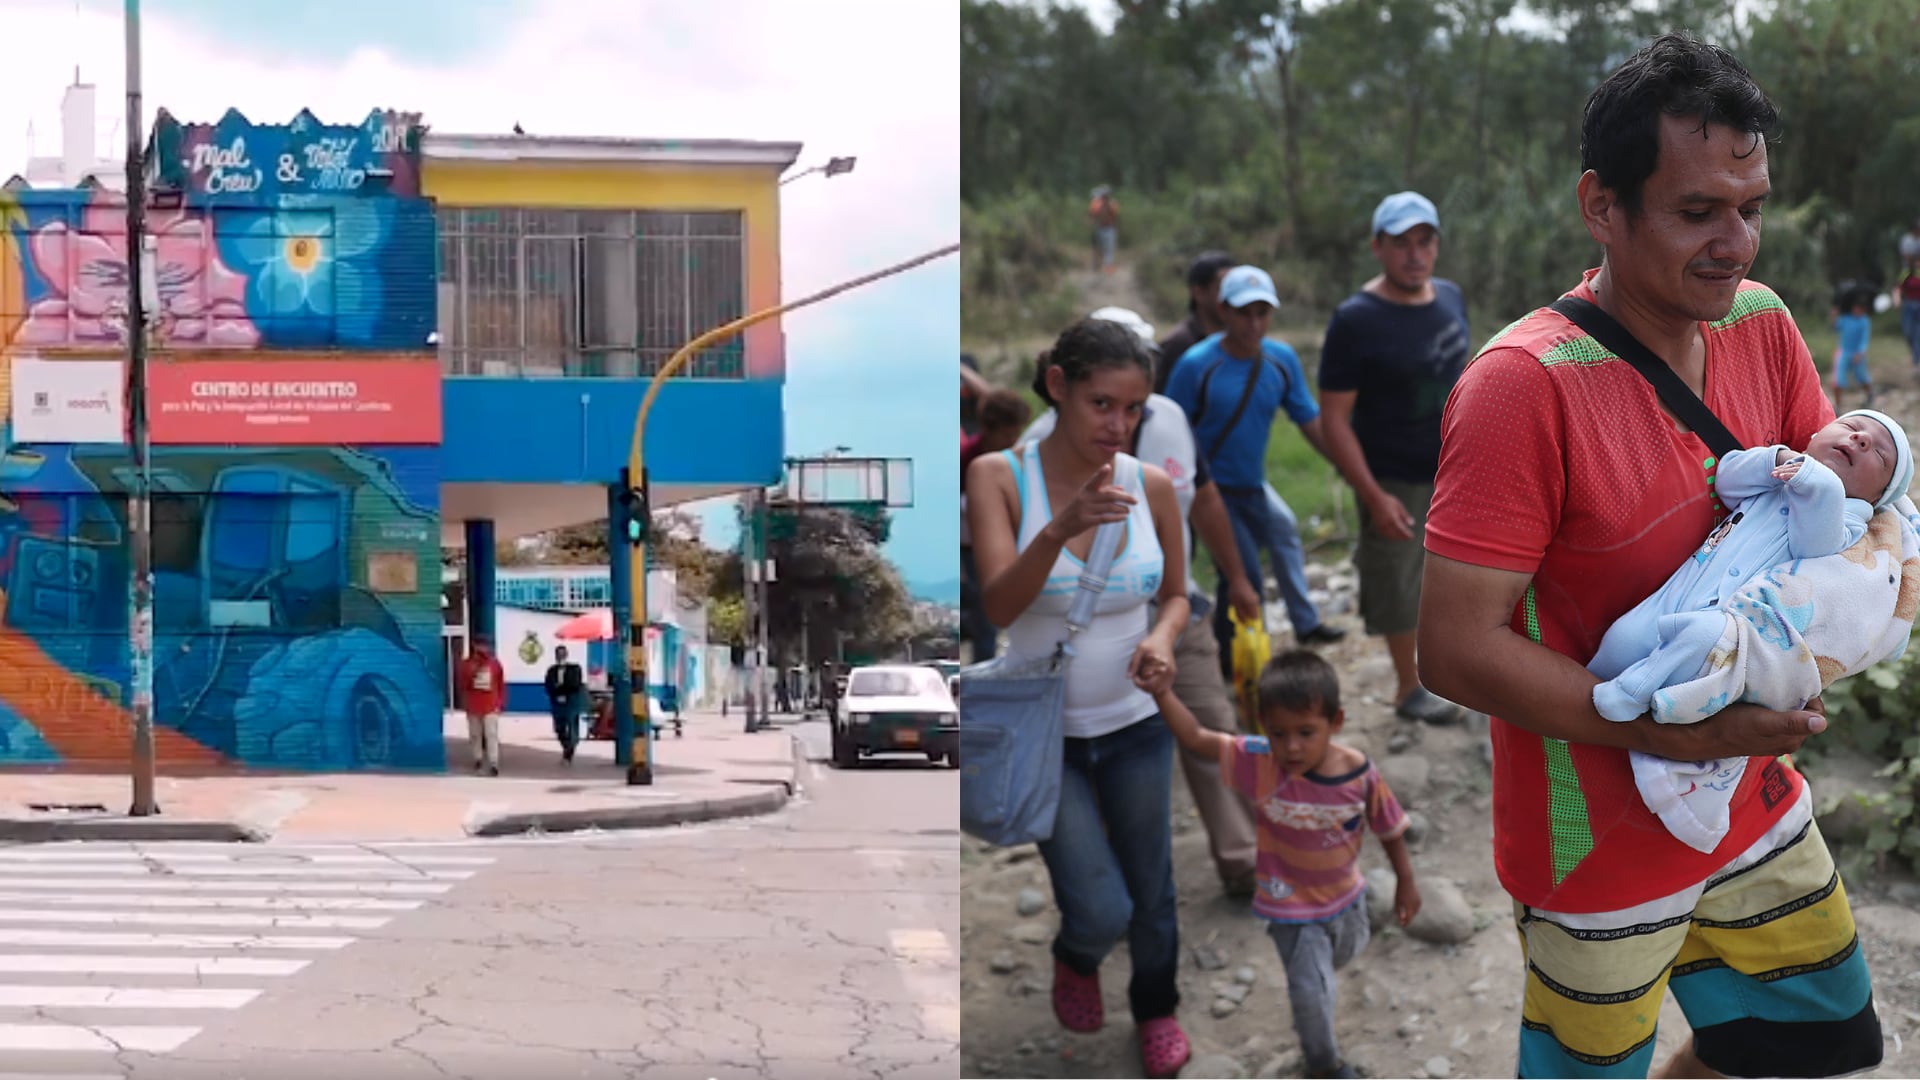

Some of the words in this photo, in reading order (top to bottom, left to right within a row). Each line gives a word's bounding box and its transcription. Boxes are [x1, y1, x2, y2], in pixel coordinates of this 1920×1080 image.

[193, 136, 250, 173] Mal
[277, 154, 304, 181] &
[191, 381, 250, 397] CENTRO
[251, 381, 272, 397] DE
[273, 381, 357, 397] ENCUENTRO
[1762, 900, 1805, 920] QUIKSILVER
[1590, 928, 1635, 939] QUIKSILVER
[1577, 993, 1625, 1002] QUIKSILVER
